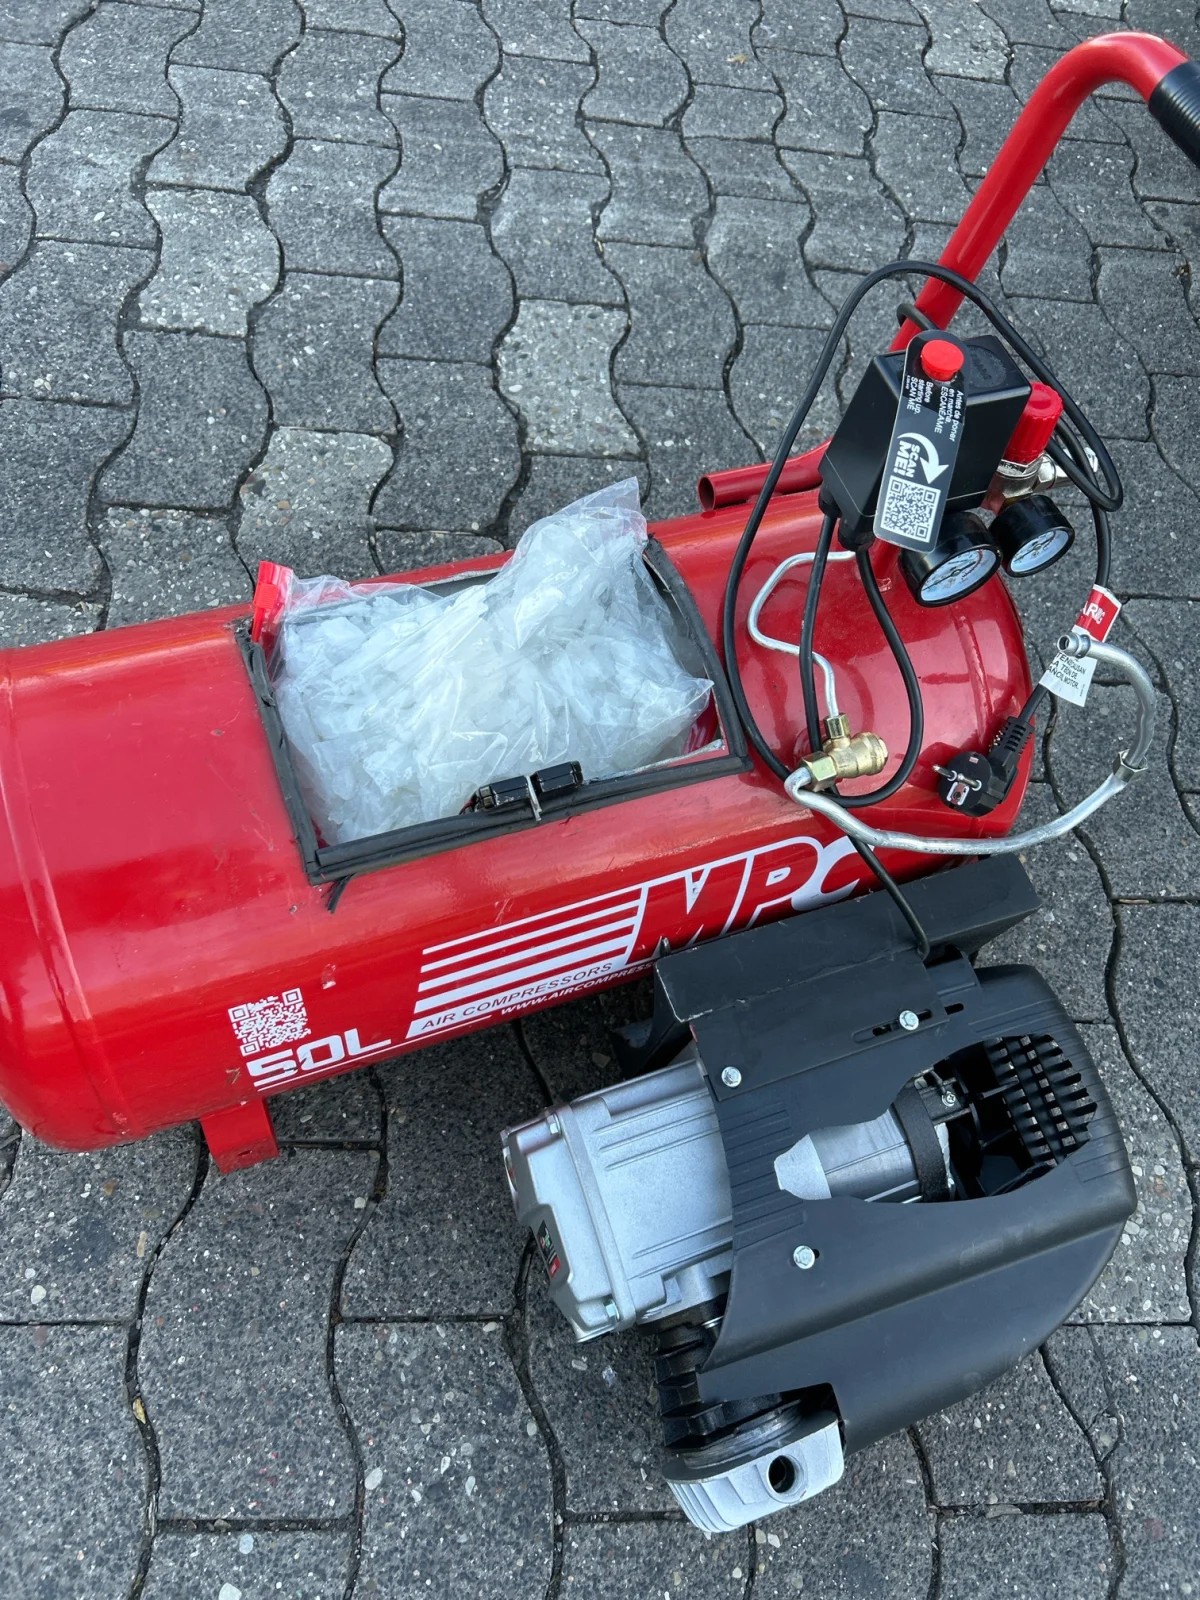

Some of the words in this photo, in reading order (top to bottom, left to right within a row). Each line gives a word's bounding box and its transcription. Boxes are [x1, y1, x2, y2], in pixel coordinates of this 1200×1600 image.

[911, 376, 919, 398] SCAN
[918, 378, 926, 403] starting
[925, 381, 934, 403] Before
[948, 388, 955, 398] en
[907, 399, 916, 410] ME
[914, 403, 922, 415] up.
[934, 386, 949, 434] ESCANÉAME
[945, 397, 954, 424] marcha.
[955, 390, 964, 409] Antes
[953, 410, 962, 420] de
[950, 419, 960, 442] poner
[894, 440, 912, 475] ME!
[906, 444, 921, 478] SCAN
[421, 1012, 456, 1031] AIR
[462, 962, 613, 1017] COMPRESSORS
[501, 962, 654, 1015] WWW.AIRCOMPRESS
[246, 1028, 391, 1087] 50L
